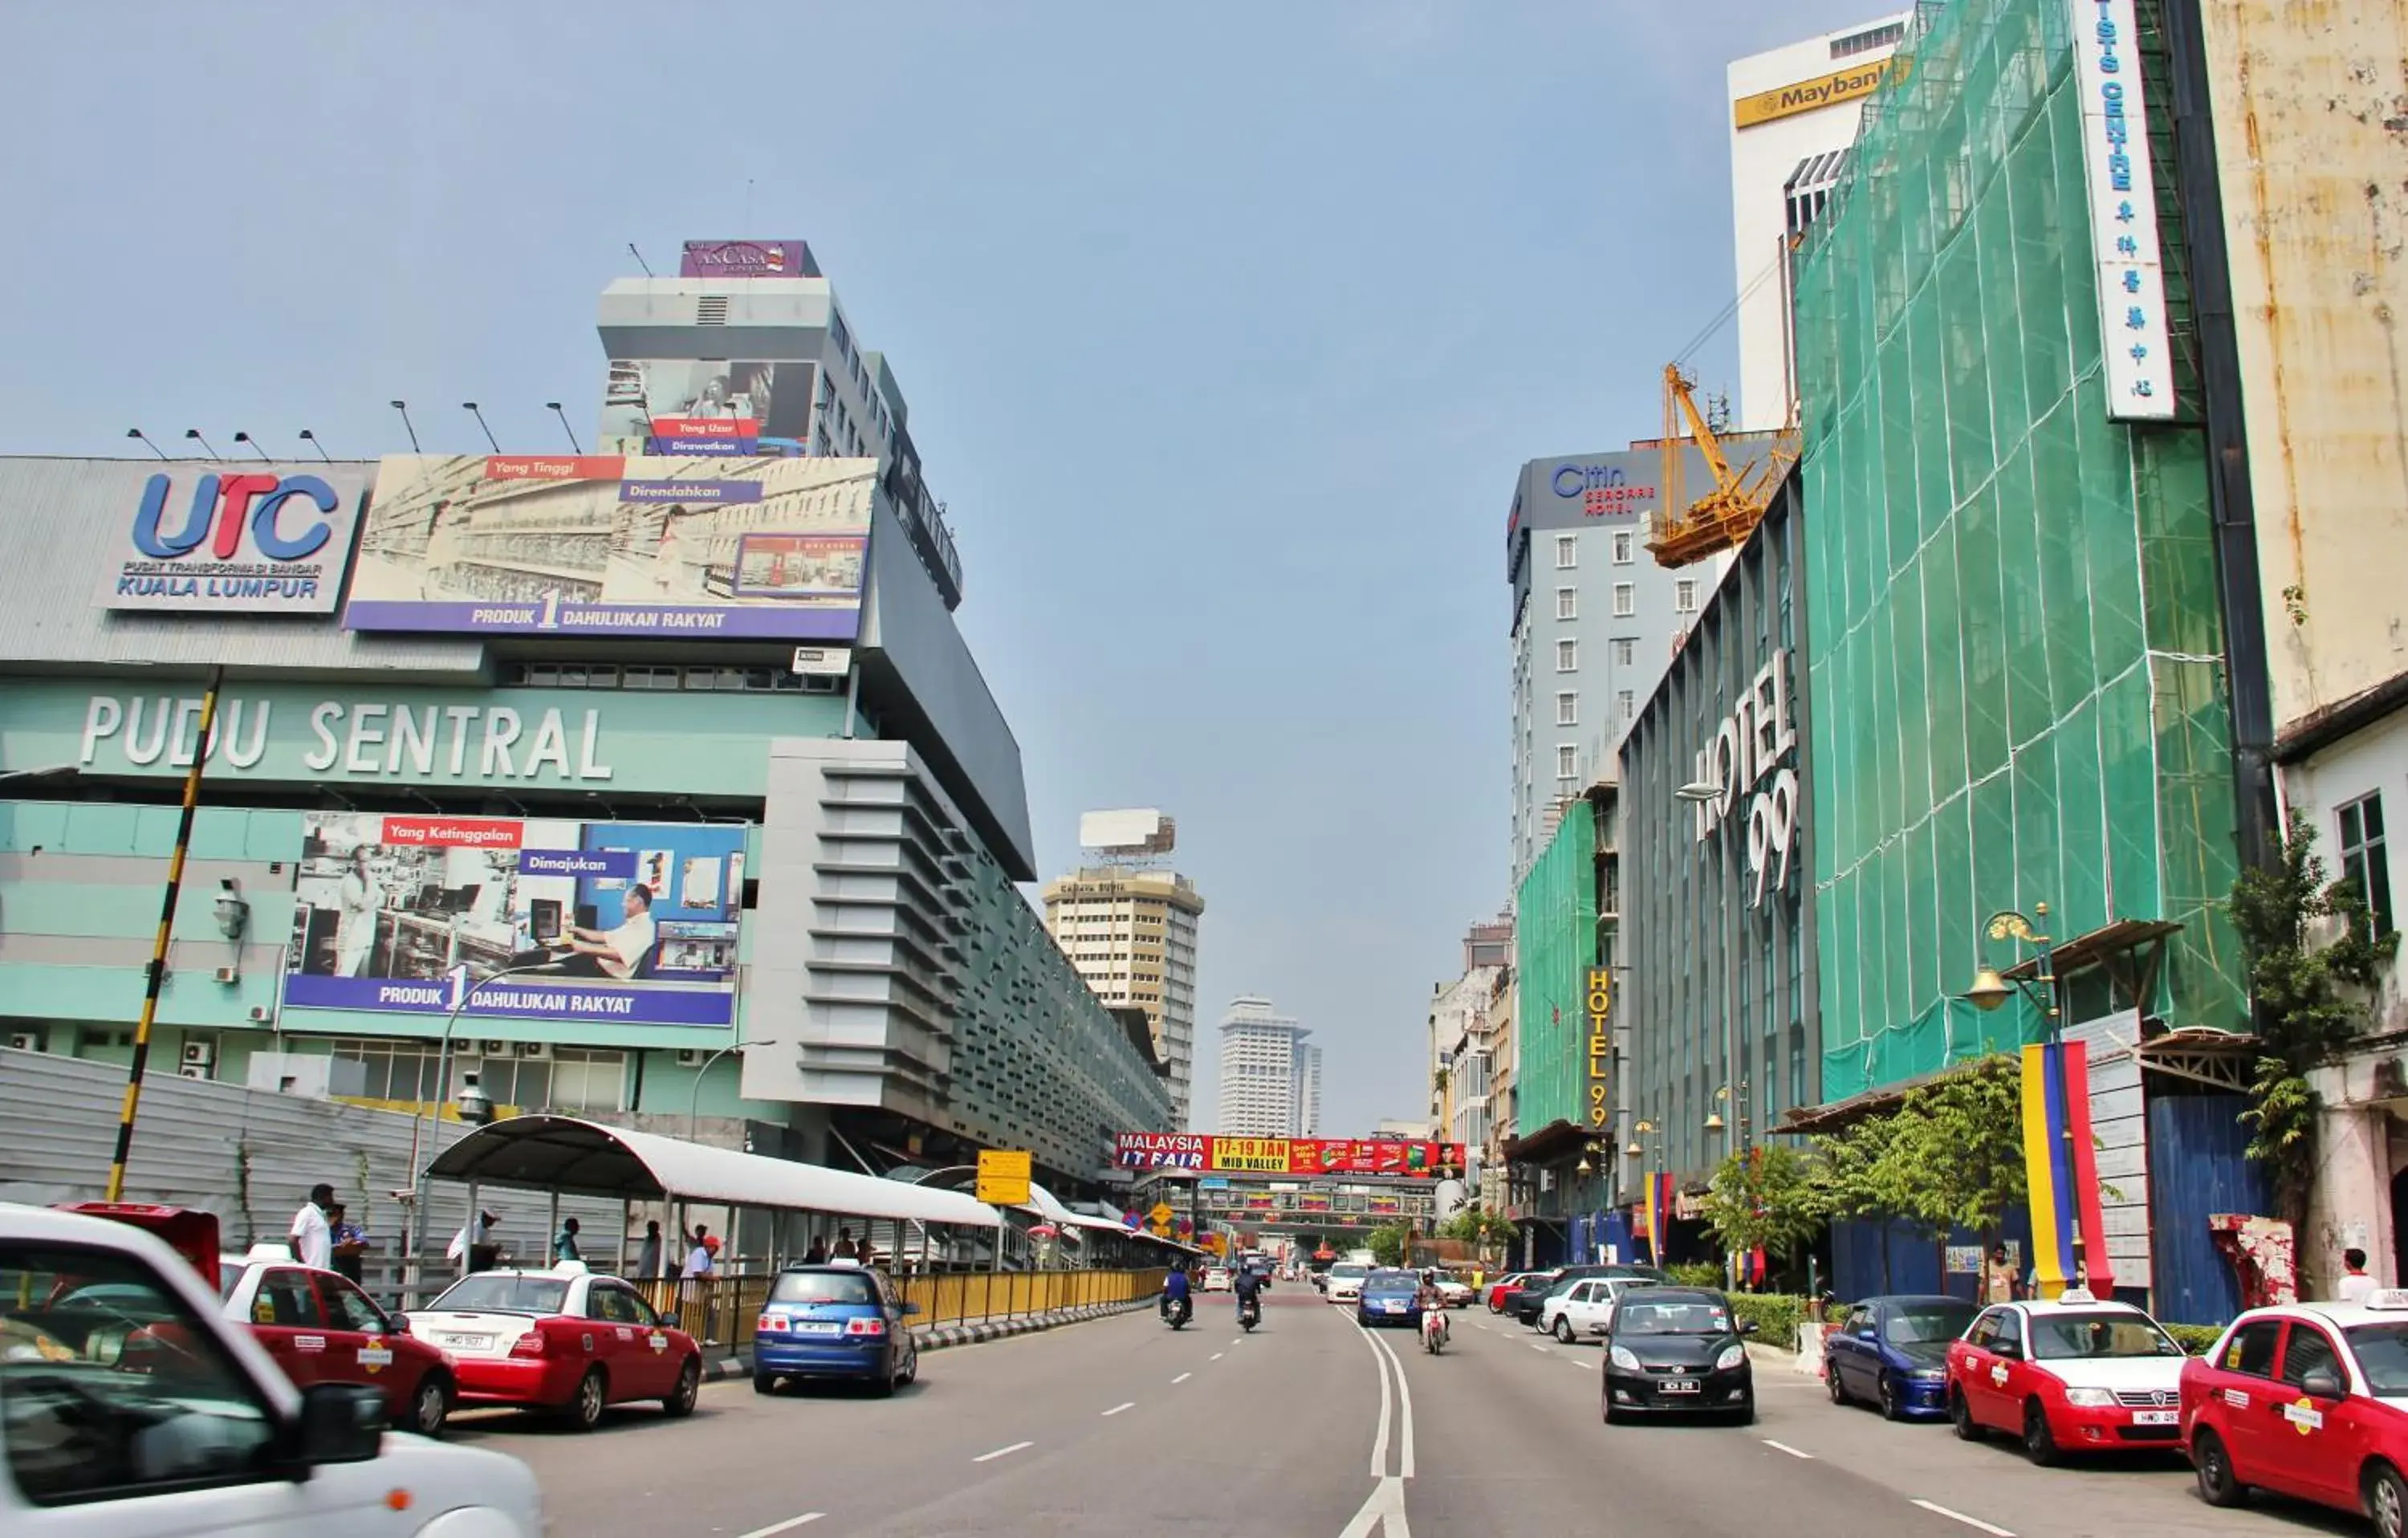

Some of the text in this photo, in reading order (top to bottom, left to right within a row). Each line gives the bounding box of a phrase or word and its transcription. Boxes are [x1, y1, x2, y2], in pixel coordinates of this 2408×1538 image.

[2101, 82, 2131, 191] CENTRE
[672, 441, 735, 450] Dirawatkan
[494, 462, 575, 474] Yang Tinggi
[629, 484, 721, 498] Direndahkan
[132, 473, 339, 560] UTC
[124, 562, 323, 576] PUSAT TRANSFORMASI BANDAR
[116, 577, 319, 598] KUALA LUMPUR
[472, 588, 726, 629] PRODUK 1 DAHULUKAN RAKYAT
[80, 696, 613, 780] PUDU SENTRAL
[1696, 648, 1796, 841] HOTEL
[391, 824, 514, 843] Yang Ketinggalan
[1749, 769, 1797, 909] 99
[529, 856, 607, 873] Dimajukan
[380, 964, 636, 1014] PRODUK 1 DAHULUKAN RAKYAT
[1588, 970, 1609, 1129] HOTEL 99
[1120, 1134, 1203, 1150] MALAYSIA
[1217, 1140, 1286, 1157] 17-19 JAN
[1121, 1151, 1203, 1168] IT FAIR
[1221, 1157, 1284, 1170] MID VALLEY
